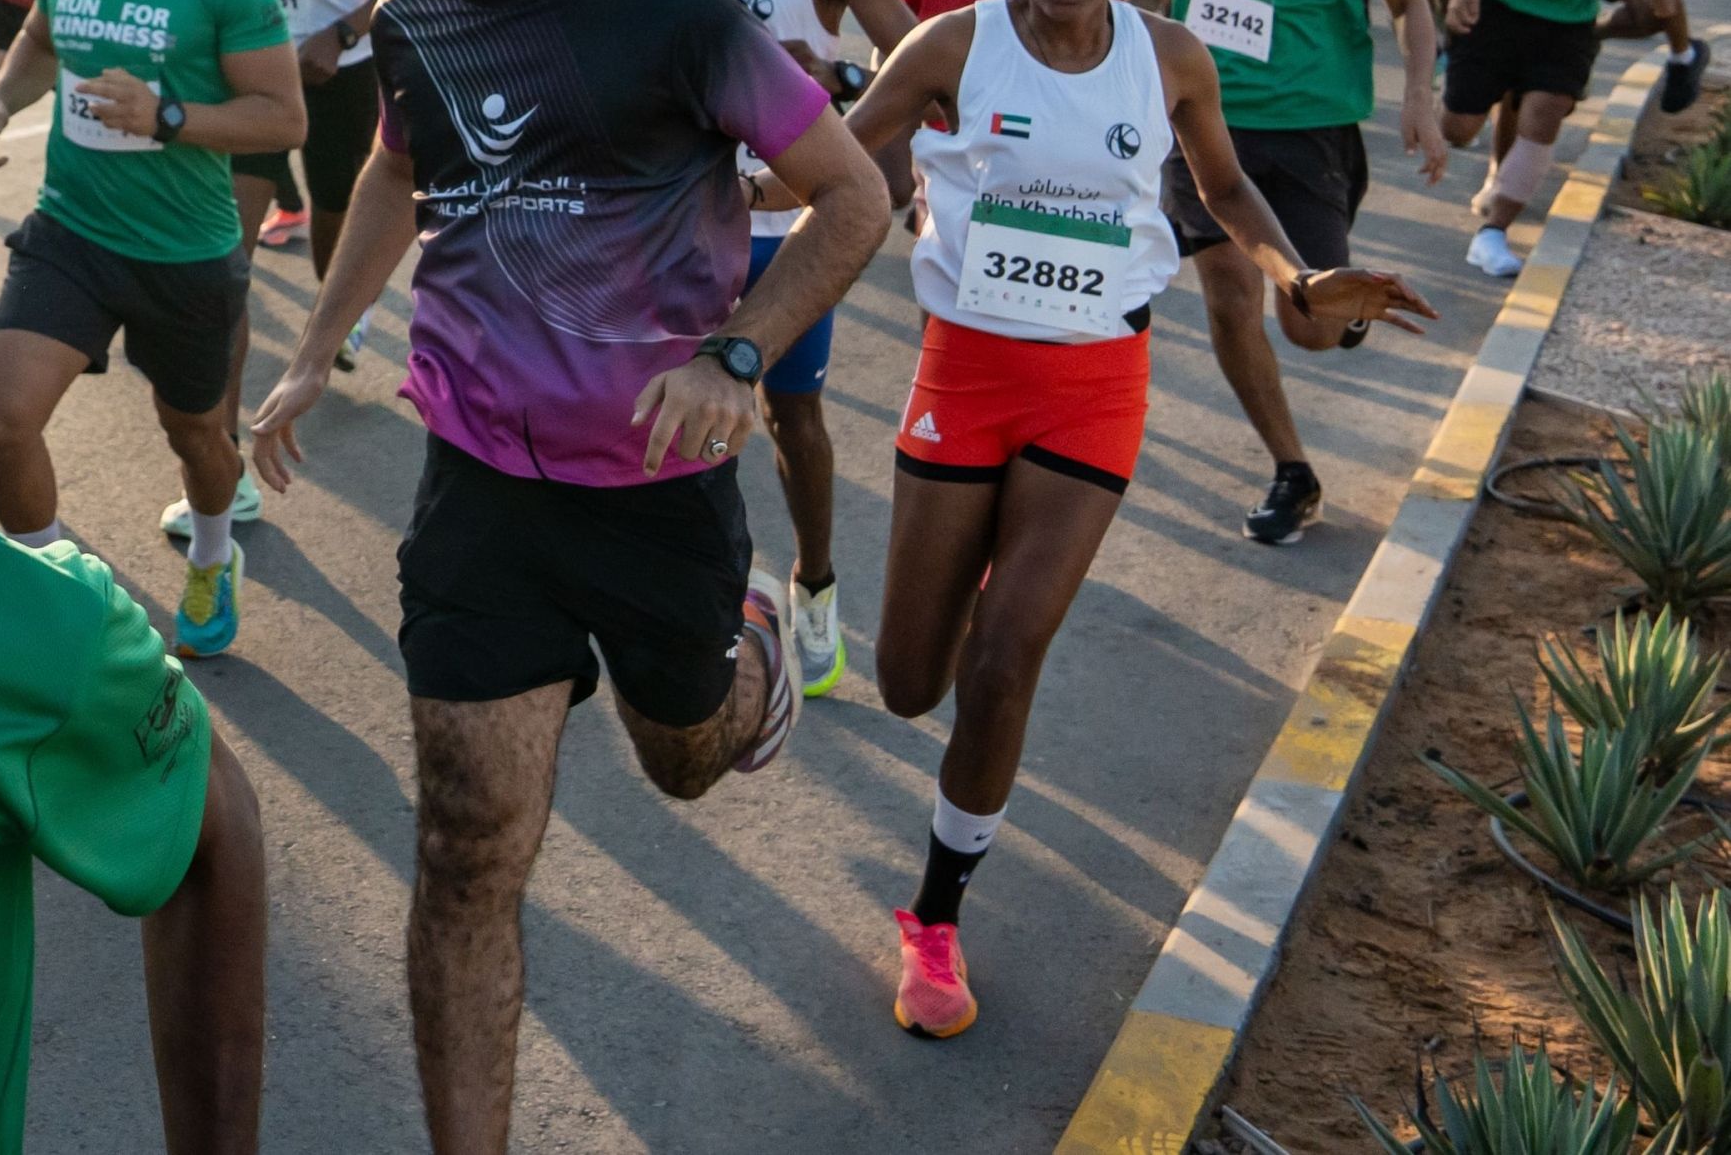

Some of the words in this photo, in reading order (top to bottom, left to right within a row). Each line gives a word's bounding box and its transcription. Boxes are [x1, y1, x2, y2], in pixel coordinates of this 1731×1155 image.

[120, 2, 171, 29] FOR
[1201, 2, 1264, 36] 32142
[52, 14, 167, 51] KINDNESS
[1019, 179, 1076, 198] خرباش
[1077, 186, 1100, 200] بن
[983, 251, 1105, 297] 32882
